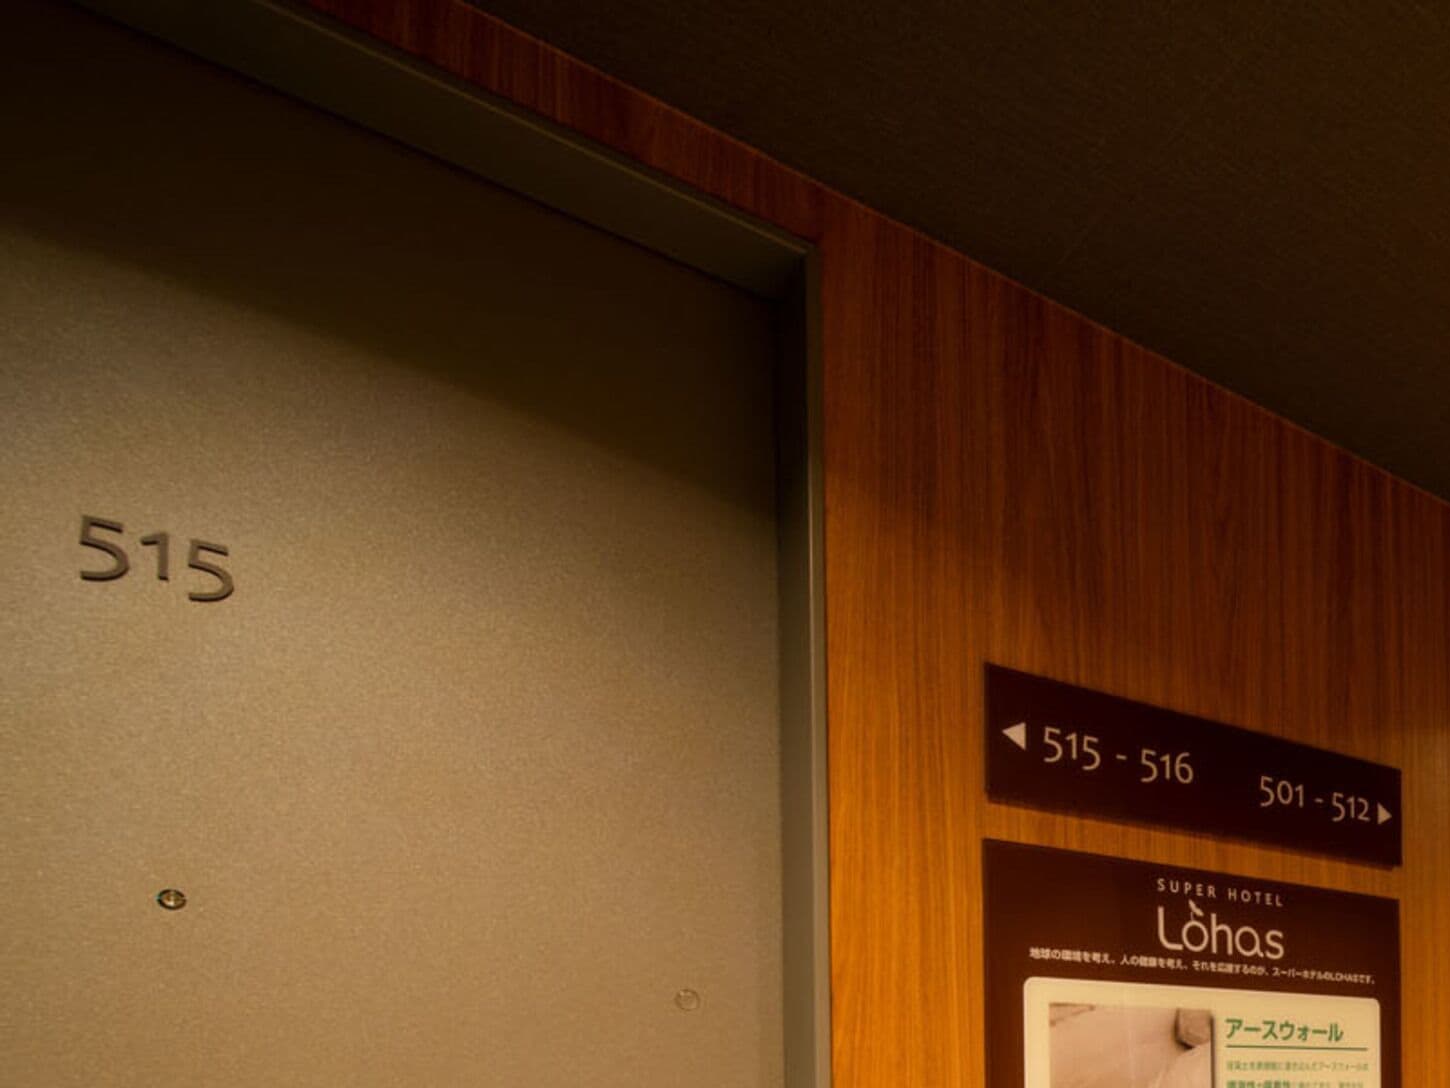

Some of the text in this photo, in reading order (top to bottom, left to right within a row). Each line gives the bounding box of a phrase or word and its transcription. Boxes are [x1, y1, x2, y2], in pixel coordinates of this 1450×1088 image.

[79, 515, 235, 603] 515
[1043, 726, 1101, 771] 515
[1140, 749, 1194, 784] 516
[1259, 775, 1305, 808] 501
[1332, 792, 1371, 823] 512
[1157, 877, 1284, 907] SUPER HOTEL
[1225, 1018, 1344, 1042] アースウォール
